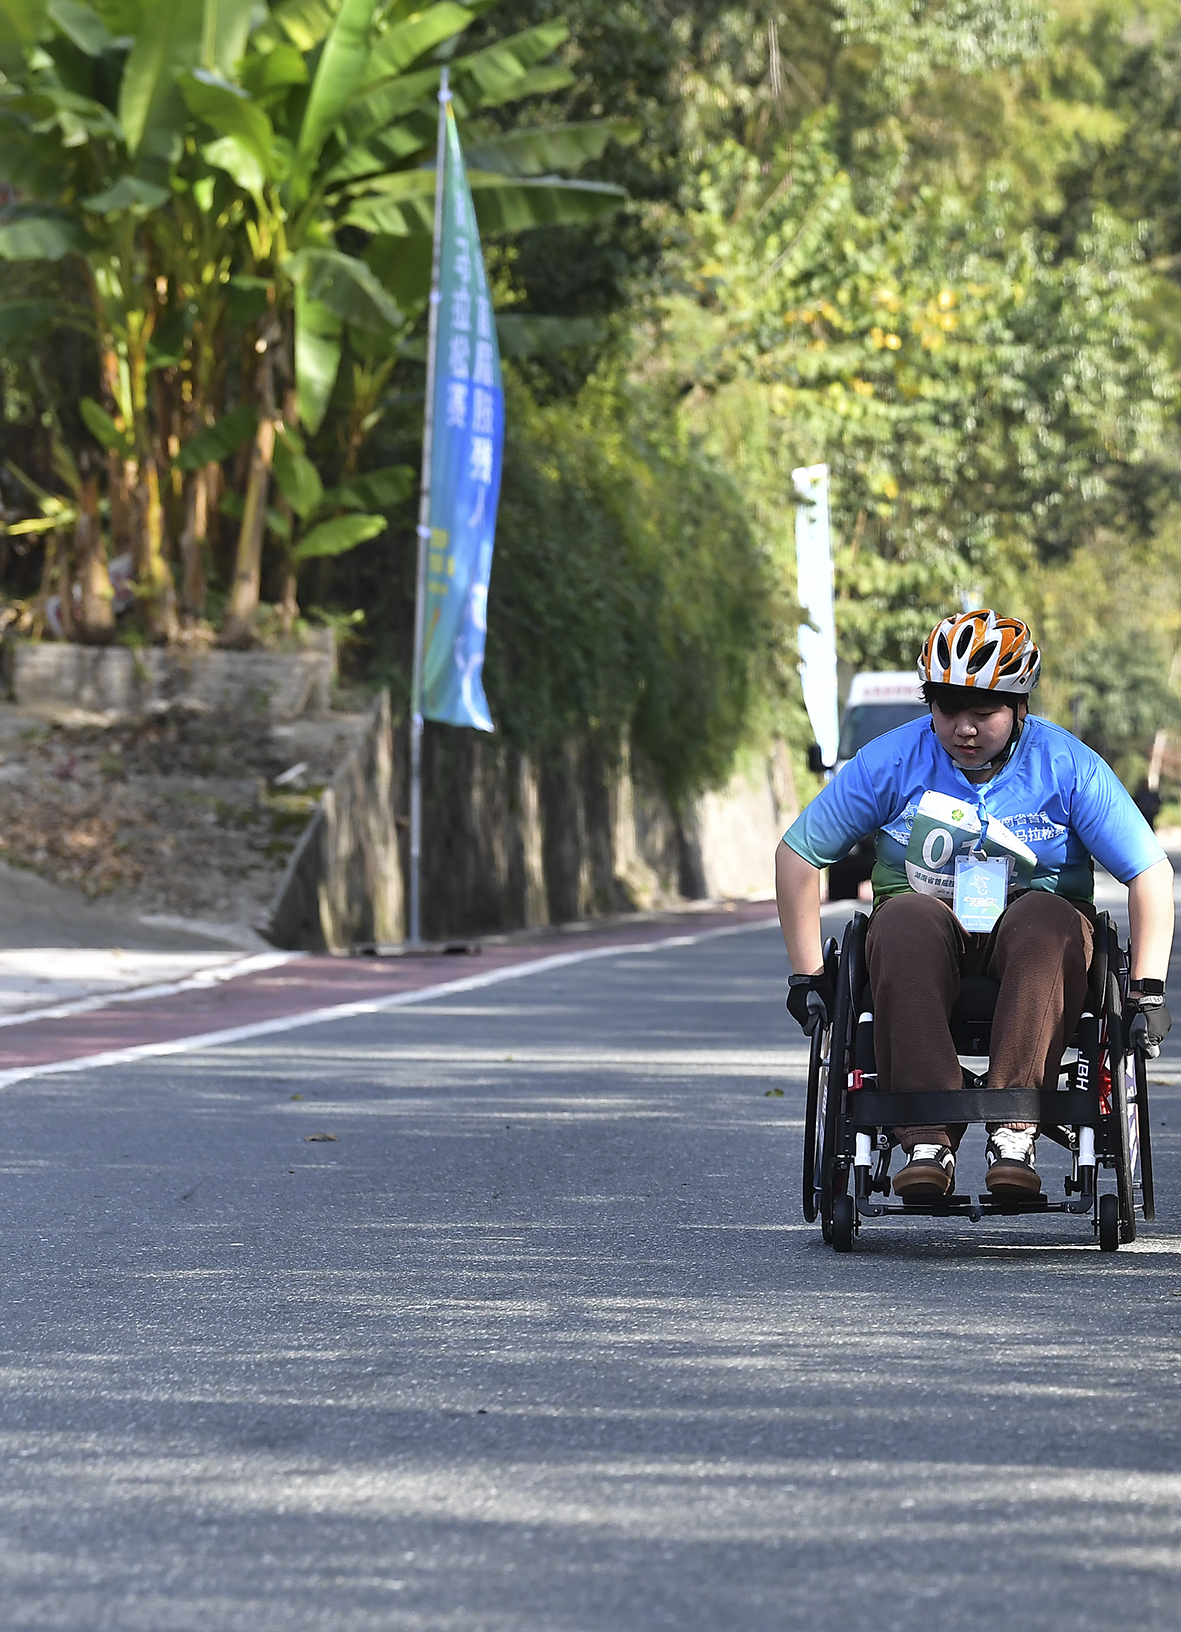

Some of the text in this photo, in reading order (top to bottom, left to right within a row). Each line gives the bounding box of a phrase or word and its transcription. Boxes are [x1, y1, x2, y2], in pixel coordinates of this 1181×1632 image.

[1000, 811, 1051, 828] 南省首届
[1013, 824, 1066, 843] 马拉松赛
